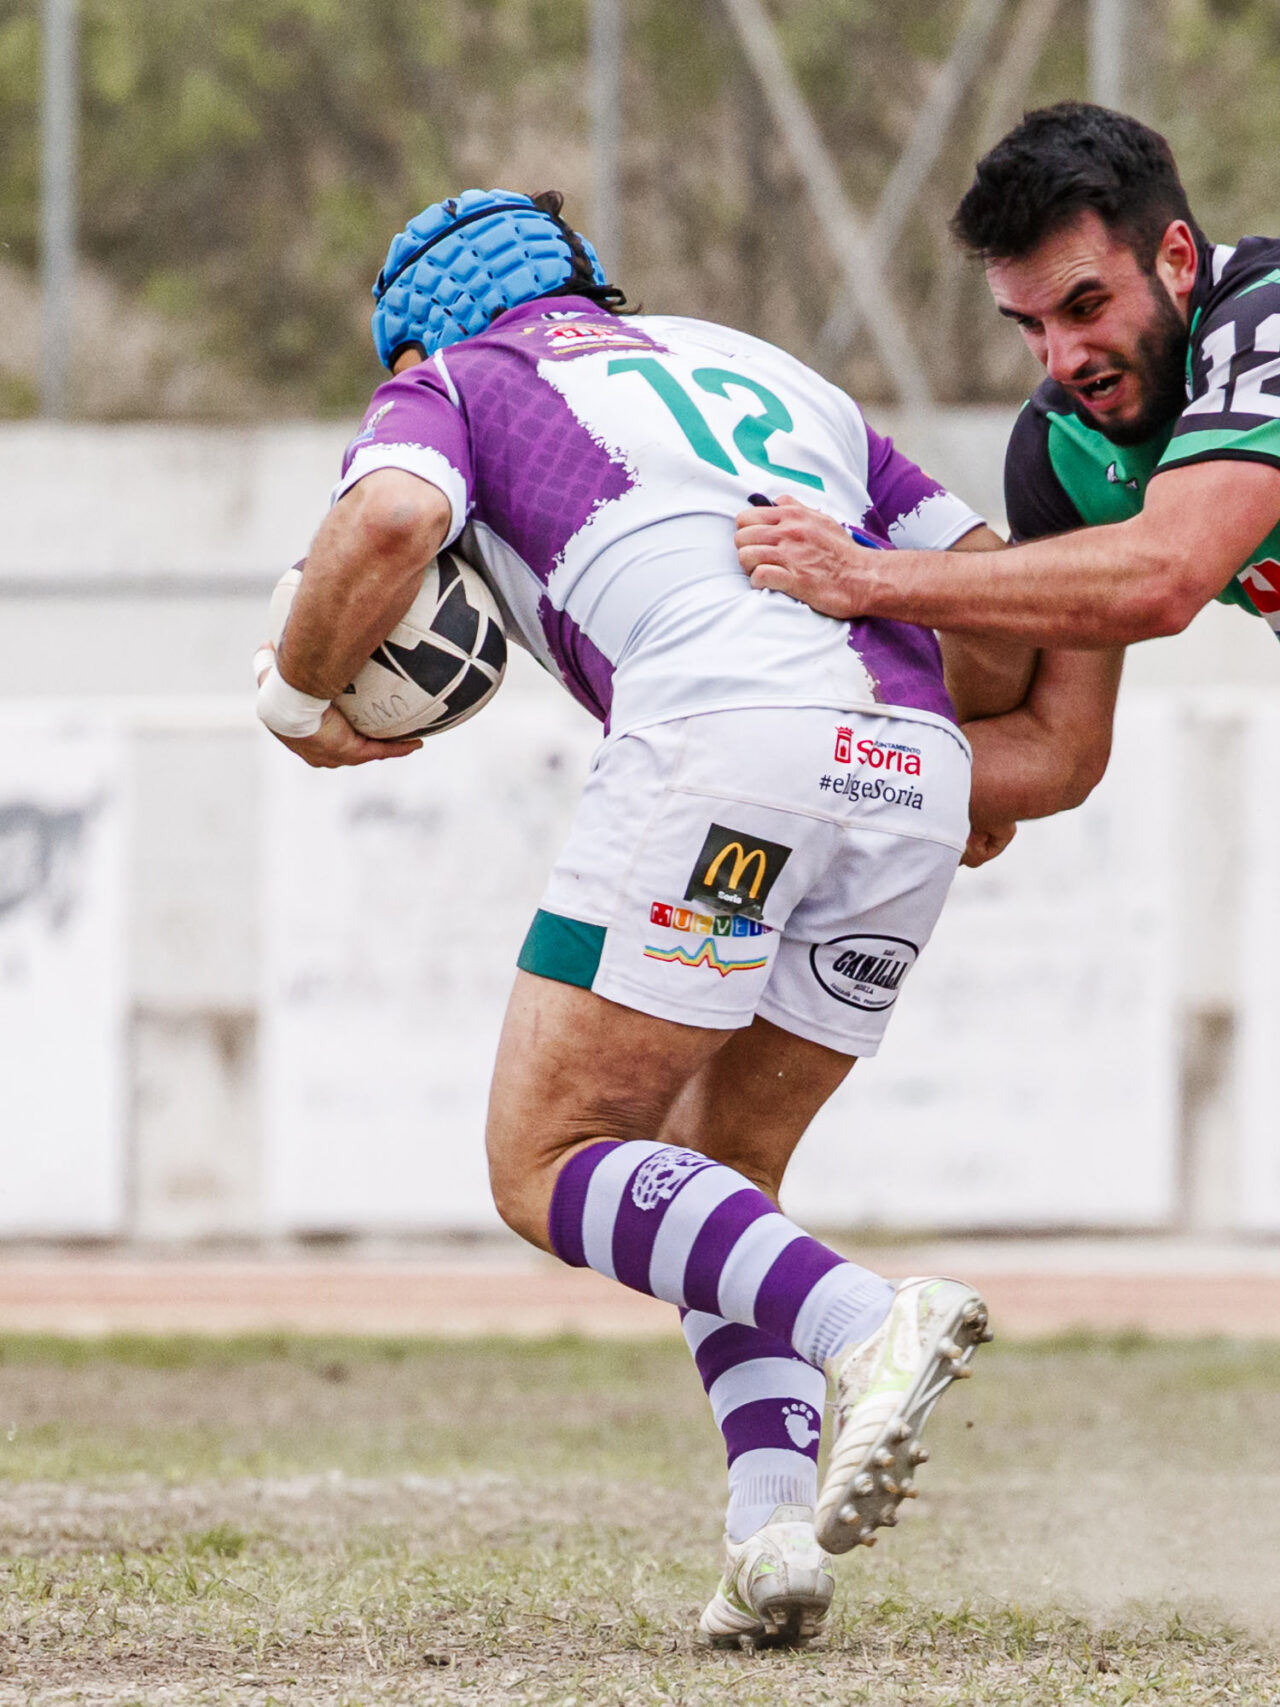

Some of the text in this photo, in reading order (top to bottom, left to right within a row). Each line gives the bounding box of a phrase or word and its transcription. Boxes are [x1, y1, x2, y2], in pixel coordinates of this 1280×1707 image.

[607, 358, 826, 492] 12
[857, 740, 921, 777] Soria
[873, 740, 922, 756] UNTAMIENTO
[819, 773, 924, 810] #elgeSoria
[650, 901, 774, 938] MUEVE
